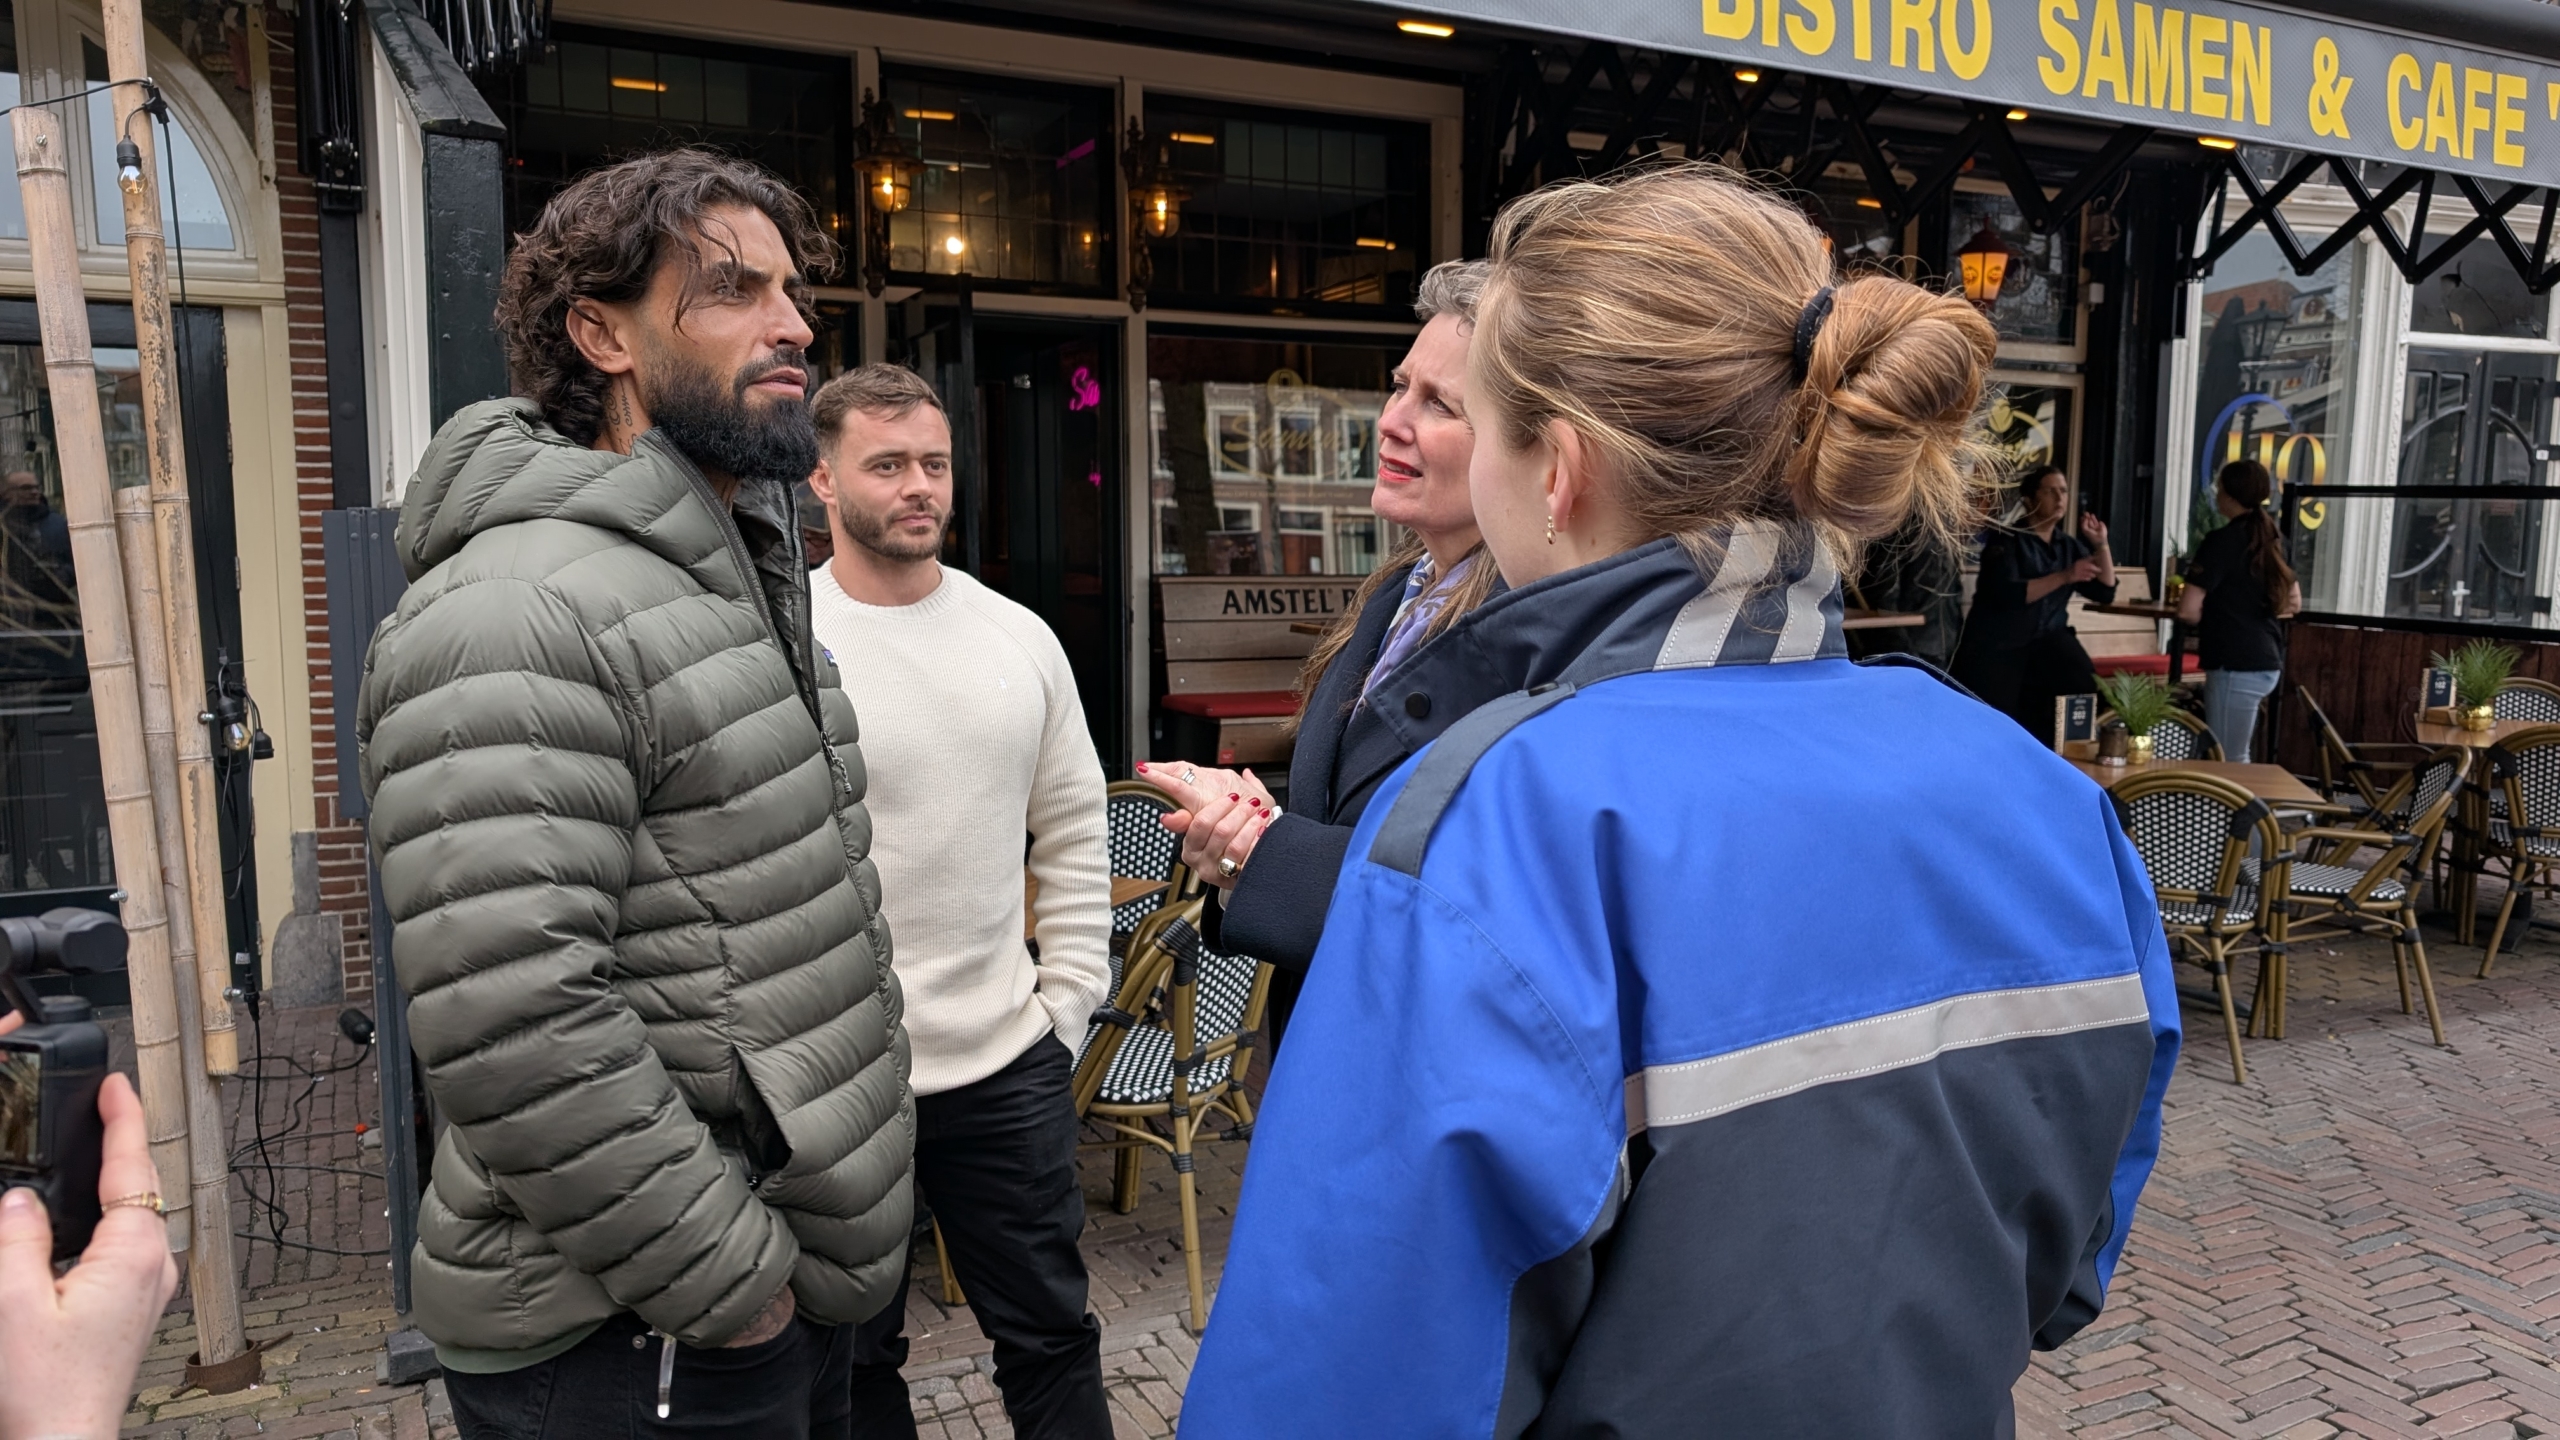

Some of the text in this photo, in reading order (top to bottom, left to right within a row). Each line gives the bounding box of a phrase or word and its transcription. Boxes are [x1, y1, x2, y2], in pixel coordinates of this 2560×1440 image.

[2037, 0, 2271, 126] SAMEN
[2308, 37, 2354, 140] &
[2387, 53, 2527, 168] CAFE
[1222, 588, 1335, 615] AMSTEL
